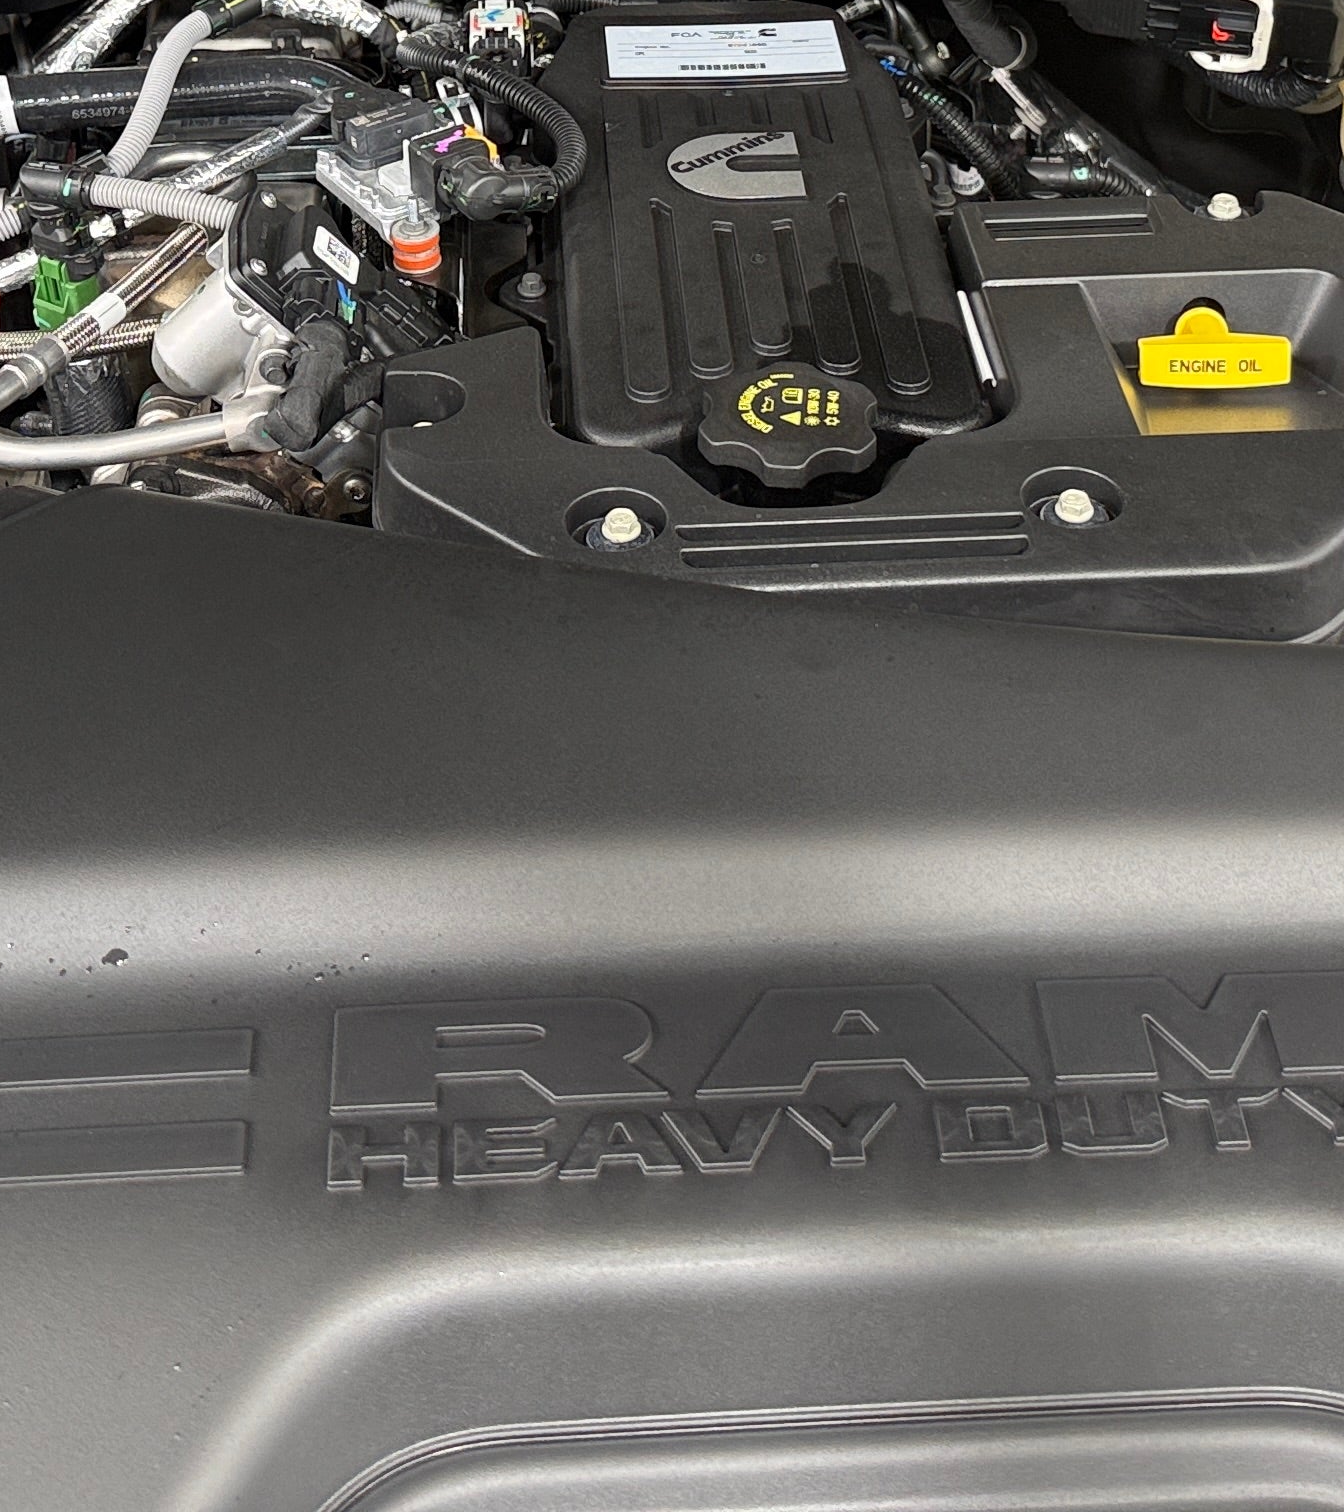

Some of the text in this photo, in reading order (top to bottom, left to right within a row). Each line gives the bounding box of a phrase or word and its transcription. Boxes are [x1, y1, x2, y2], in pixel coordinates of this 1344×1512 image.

[671, 131, 785, 173] Cummins
[1169, 359, 1262, 373] ENGINE OIL
[738, 385, 762, 410] ENGINE
[757, 378, 778, 389] OIL
[326, 1101, 898, 1191] HEAVY
